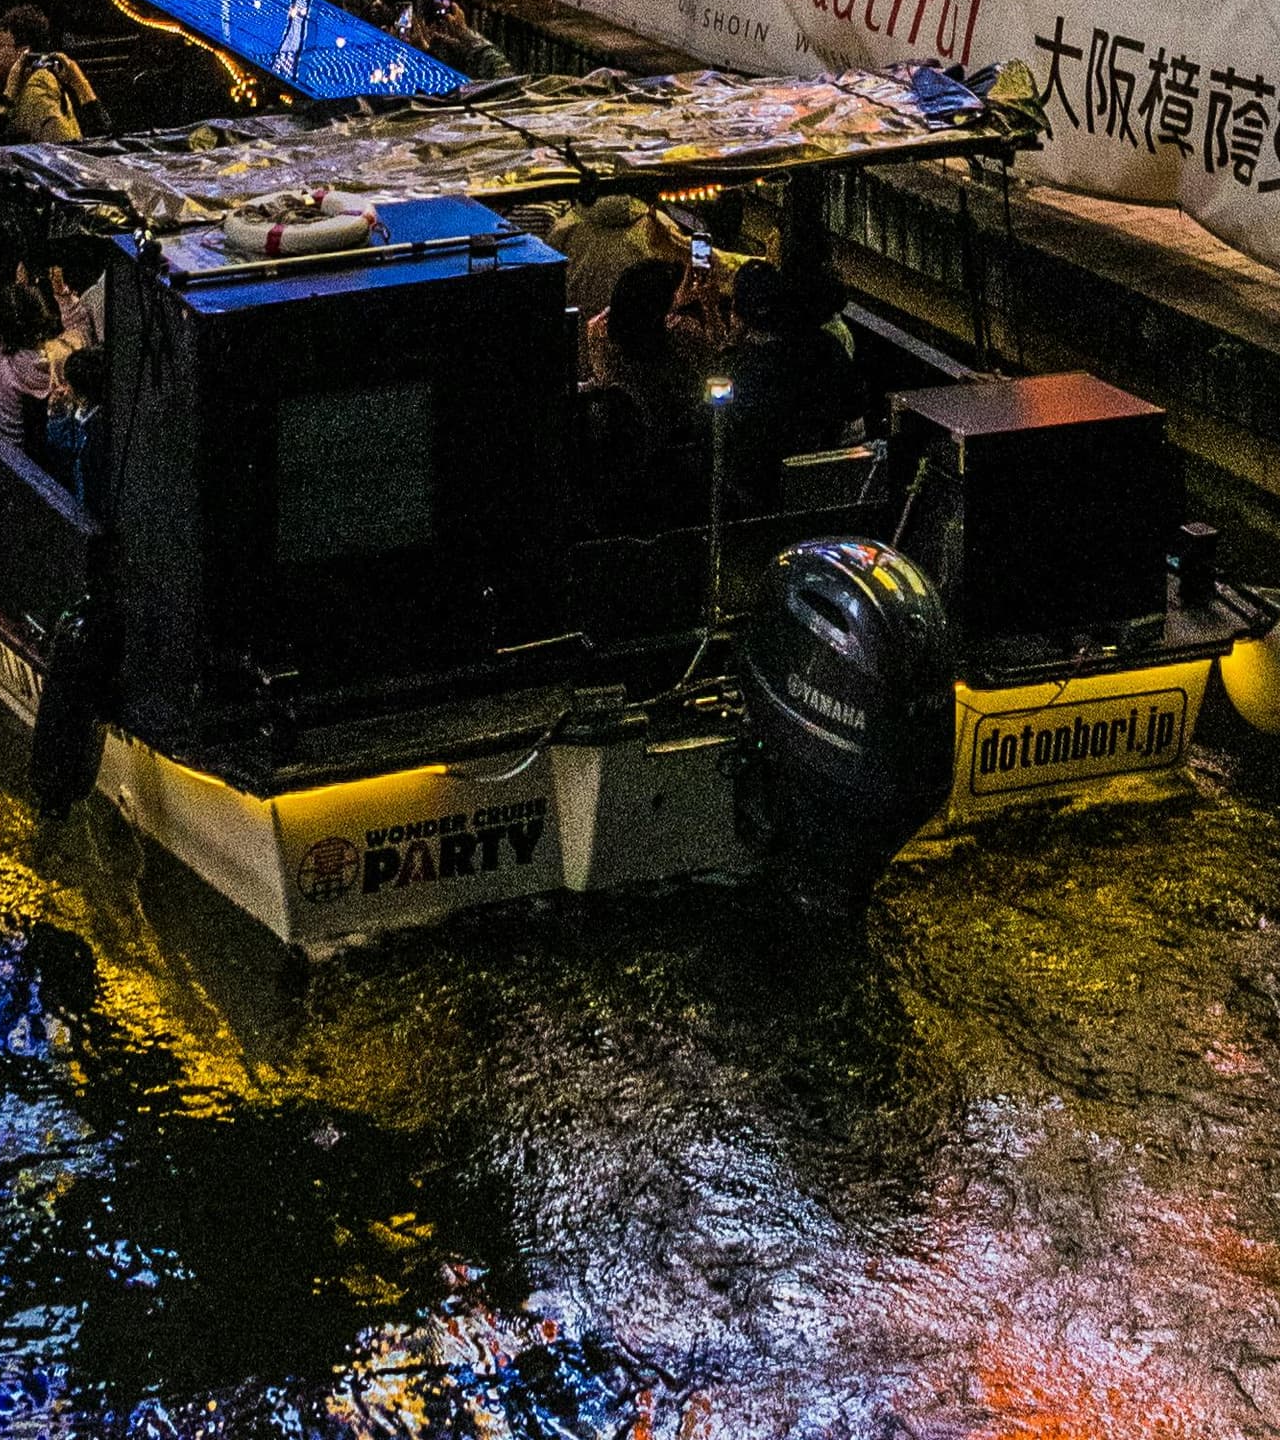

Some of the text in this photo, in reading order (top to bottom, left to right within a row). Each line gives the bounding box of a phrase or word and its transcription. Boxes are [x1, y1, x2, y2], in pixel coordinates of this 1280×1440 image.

[703, 13, 771, 44] SHOIN
[804, 683, 867, 730] YAMAHA
[979, 709, 1176, 775] dotonbori.jp
[366, 814, 468, 847] WONDER
[363, 819, 543, 900] PARTY
